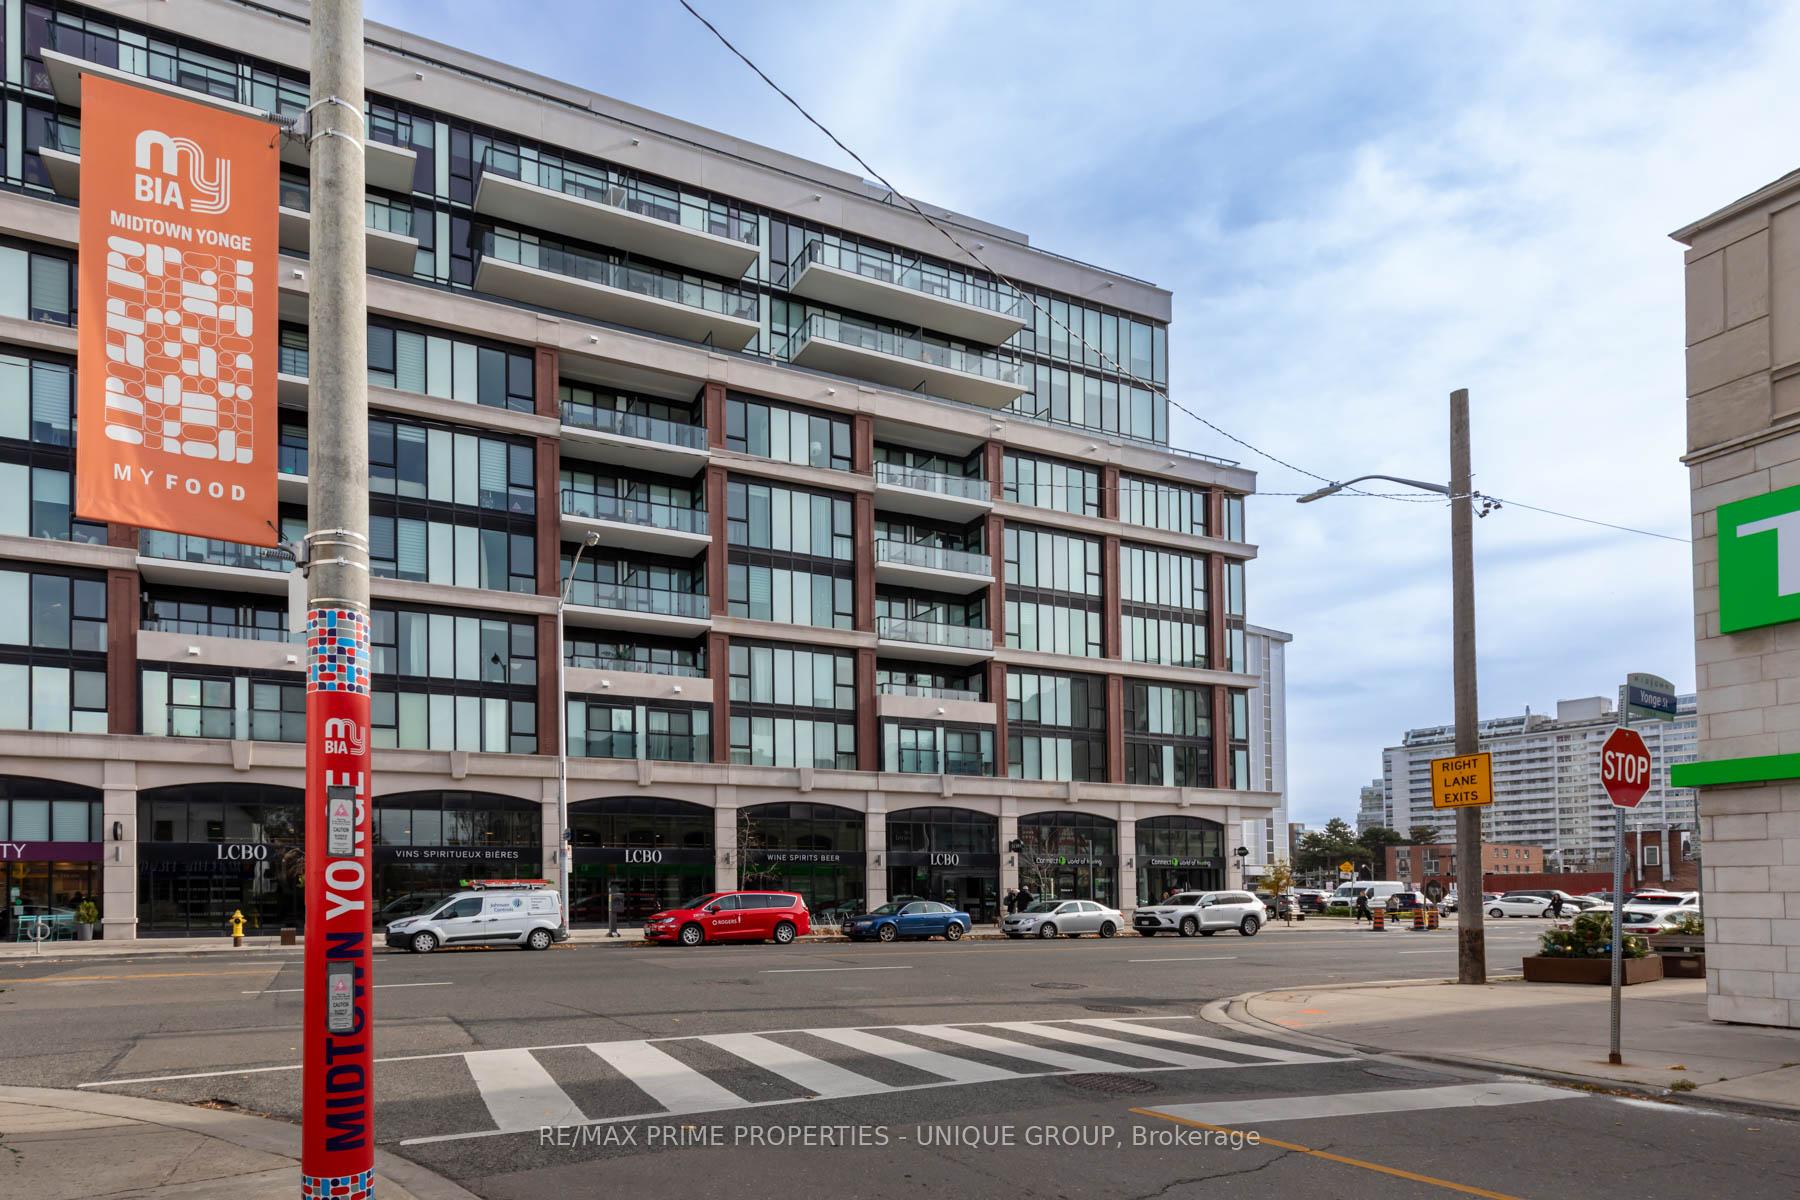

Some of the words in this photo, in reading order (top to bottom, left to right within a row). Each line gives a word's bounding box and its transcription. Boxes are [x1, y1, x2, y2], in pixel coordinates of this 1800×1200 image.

[135, 173, 185, 210] BIA
[110, 210, 193, 242] MIDTOWN
[196, 228, 252, 252] YONGE
[113, 463, 154, 485] MY
[165, 473, 246, 502] FOOD
[1640, 689, 1661, 708] Yonge
[325, 740, 348, 754] BIA
[1442, 758, 1478, 772] RIGHT
[1604, 750, 1648, 785] STOP
[1444, 774, 1478, 788] LANE
[1444, 790, 1479, 803] EXITS
[0, 843, 26, 858] TY
[217, 844, 268, 860] LCBO
[325, 769, 365, 920] YOE
[395, 850, 420, 858] VINS
[423, 850, 482, 858] SPIRITUEUX
[485, 850, 519, 859] BIÈRES
[625, 849, 662, 863] LCBO
[789, 854, 818, 862] SPIRITS
[820, 854, 840, 862] BEER
[930, 853, 960, 866] LCBO
[325, 932, 365, 1152] MIDTN
